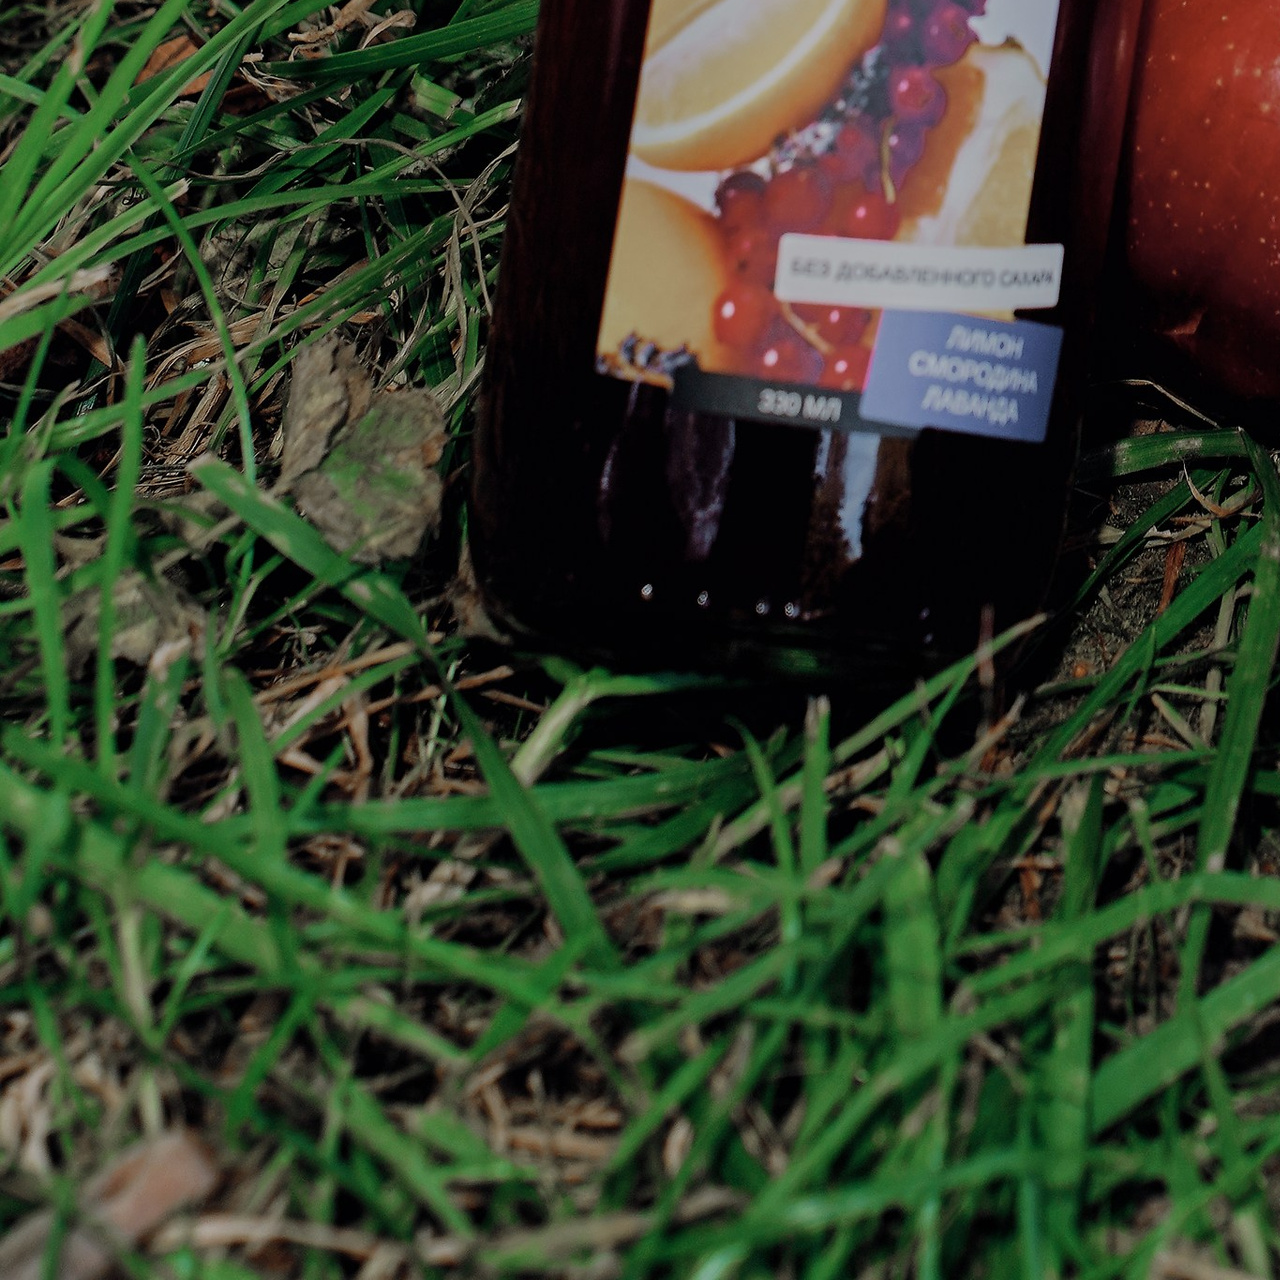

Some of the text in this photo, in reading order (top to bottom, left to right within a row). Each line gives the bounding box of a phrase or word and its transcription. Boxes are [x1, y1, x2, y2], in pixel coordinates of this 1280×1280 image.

[790, 258, 830, 278] БЕЗ
[834, 263, 995, 289] ДОБАВЛЕННОГО
[946, 325, 1024, 358] ЛИМОН
[908, 348, 1039, 394] СМОРОДИНА
[758, 388, 843, 422] 330 МЛ
[920, 384, 1020, 427] ЛАВАНДА
